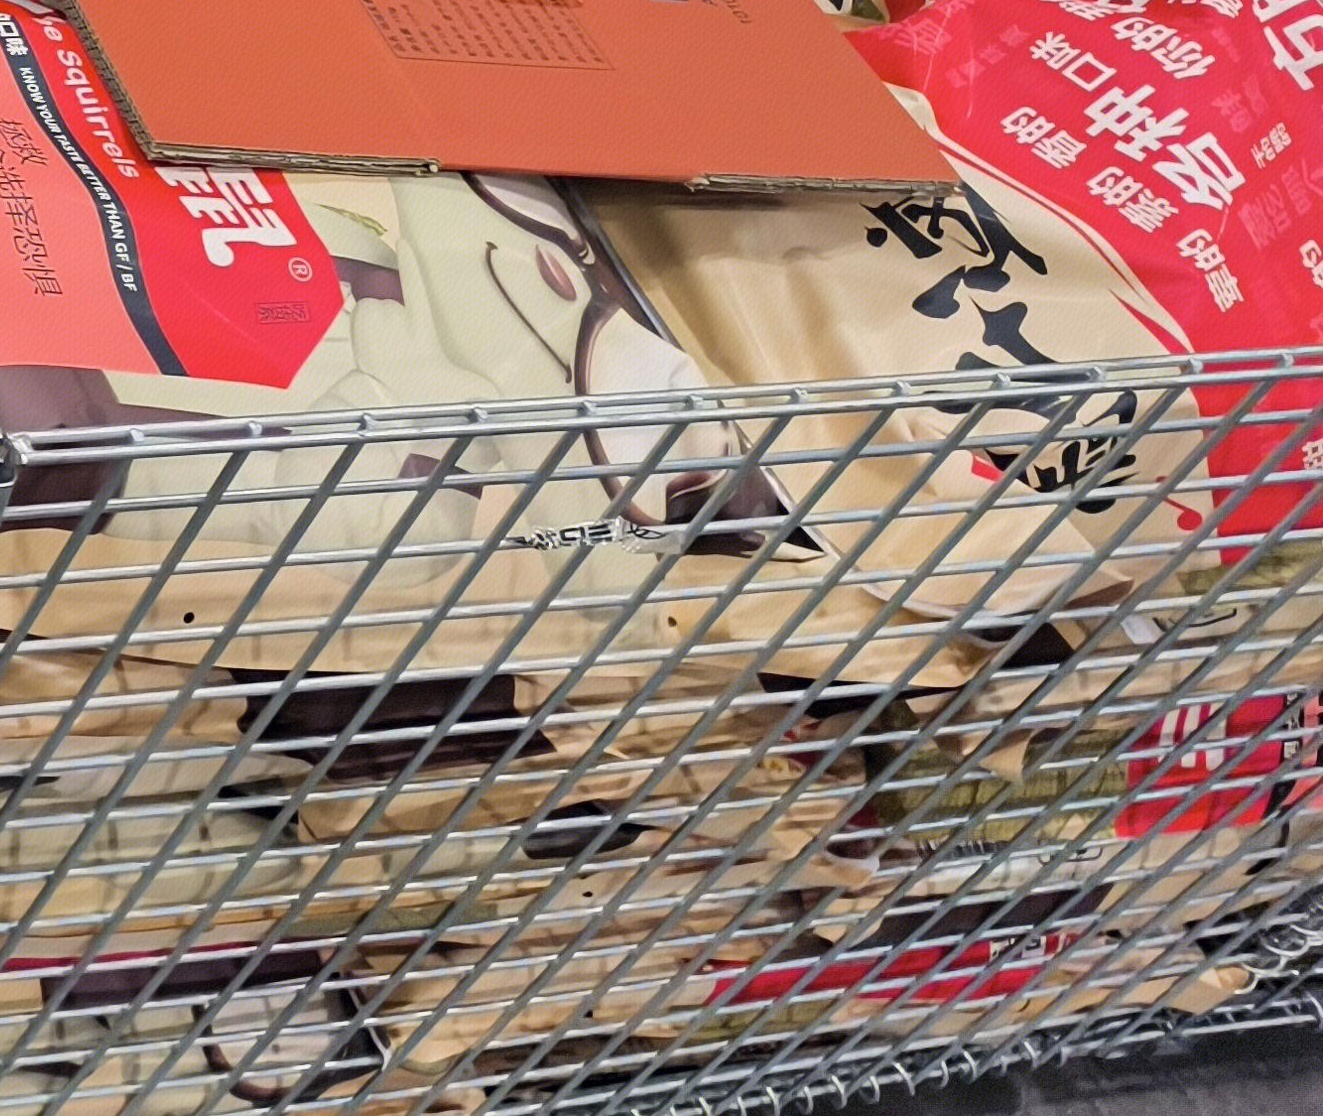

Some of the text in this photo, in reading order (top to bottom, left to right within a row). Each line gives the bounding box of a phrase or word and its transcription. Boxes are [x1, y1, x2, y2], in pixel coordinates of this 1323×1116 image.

[1029, 31, 1117, 91] 口味
[1111, 16, 1216, 80] 你的
[19, 67, 46, 105] KNOW
[36, 100, 62, 134] YOUR
[57, 48, 140, 178] Squirrels
[53, 133, 83, 167] TASTE
[1000, 106, 1088, 169] 香的
[1083, 84, 1249, 211] 各种
[76, 162, 111, 203] BETTER
[1086, 166, 1180, 233] 素的
[102, 200, 126, 241] THAN
[113, 242, 130, 262] GF
[120, 272, 137, 293] BF
